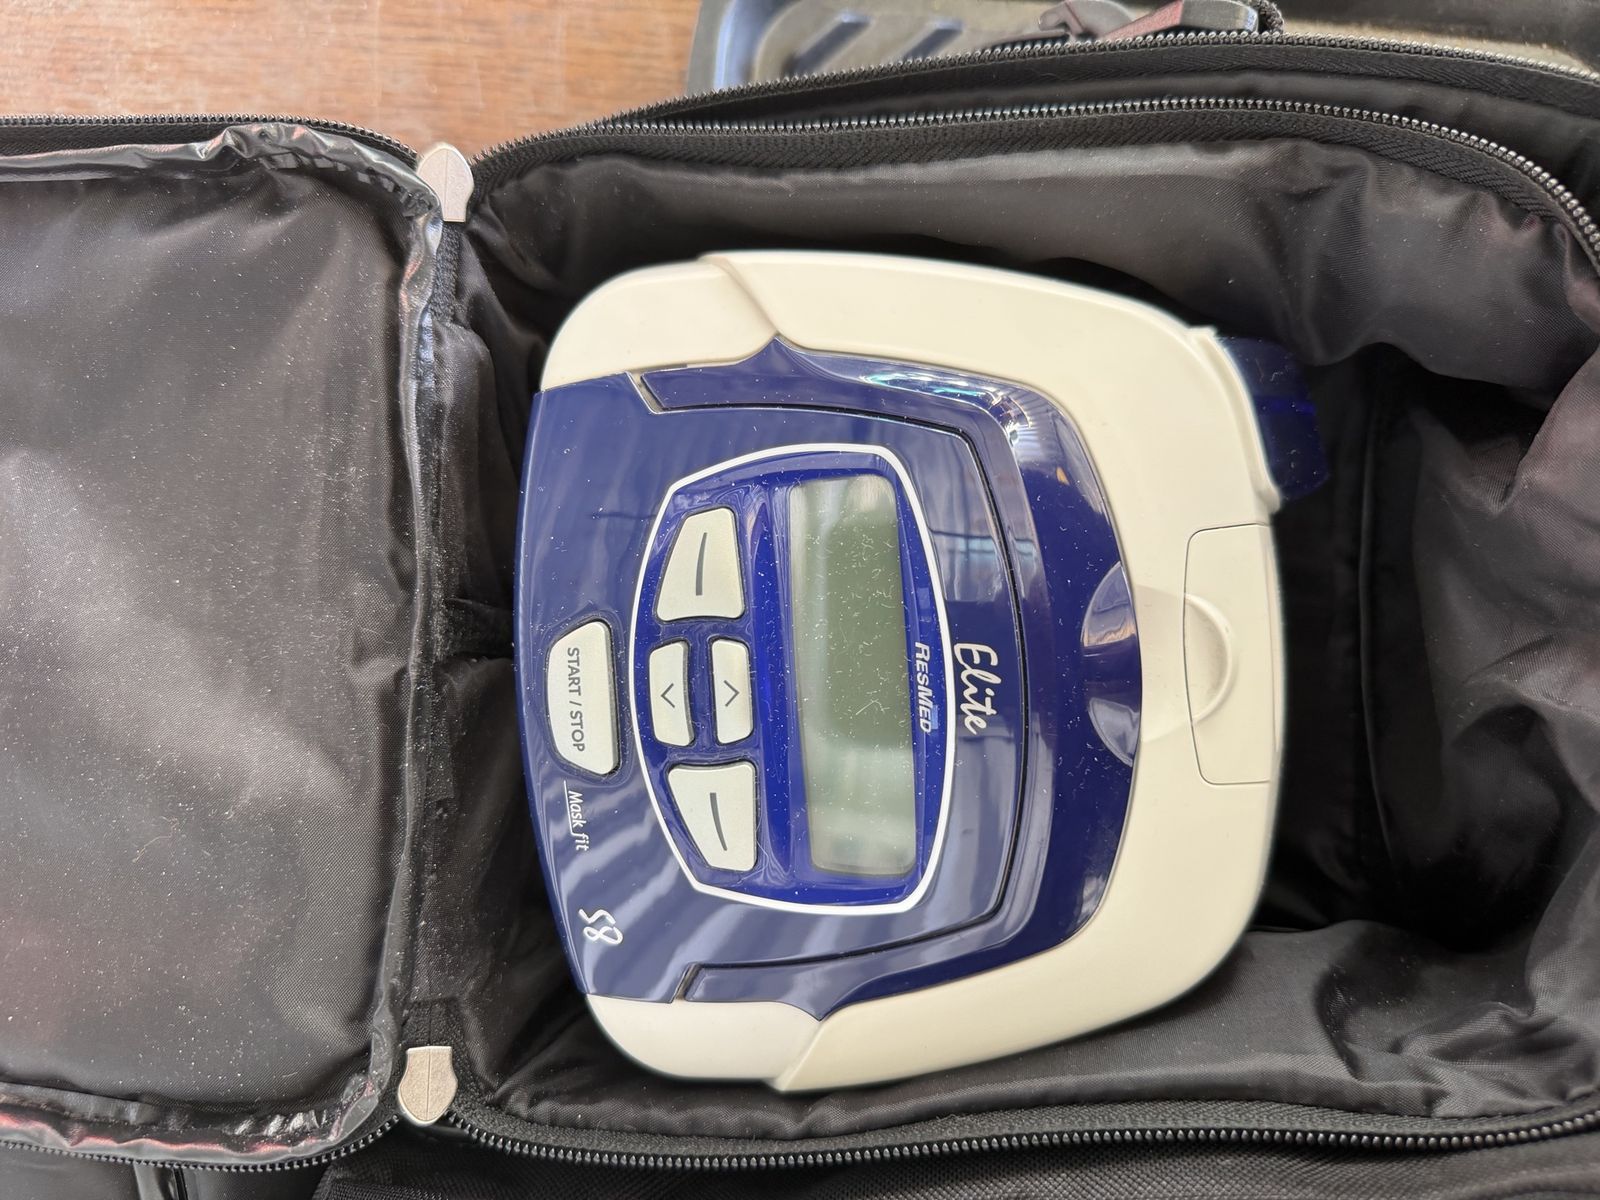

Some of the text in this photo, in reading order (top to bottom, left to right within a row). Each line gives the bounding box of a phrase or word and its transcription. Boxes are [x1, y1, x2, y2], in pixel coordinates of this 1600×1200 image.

[567, 647, 582, 696] START
[954, 643, 1002, 735] Elite
[571, 711, 585, 752] STOP
[568, 790, 590, 852] Mask fit
[578, 908, 623, 945] S8
